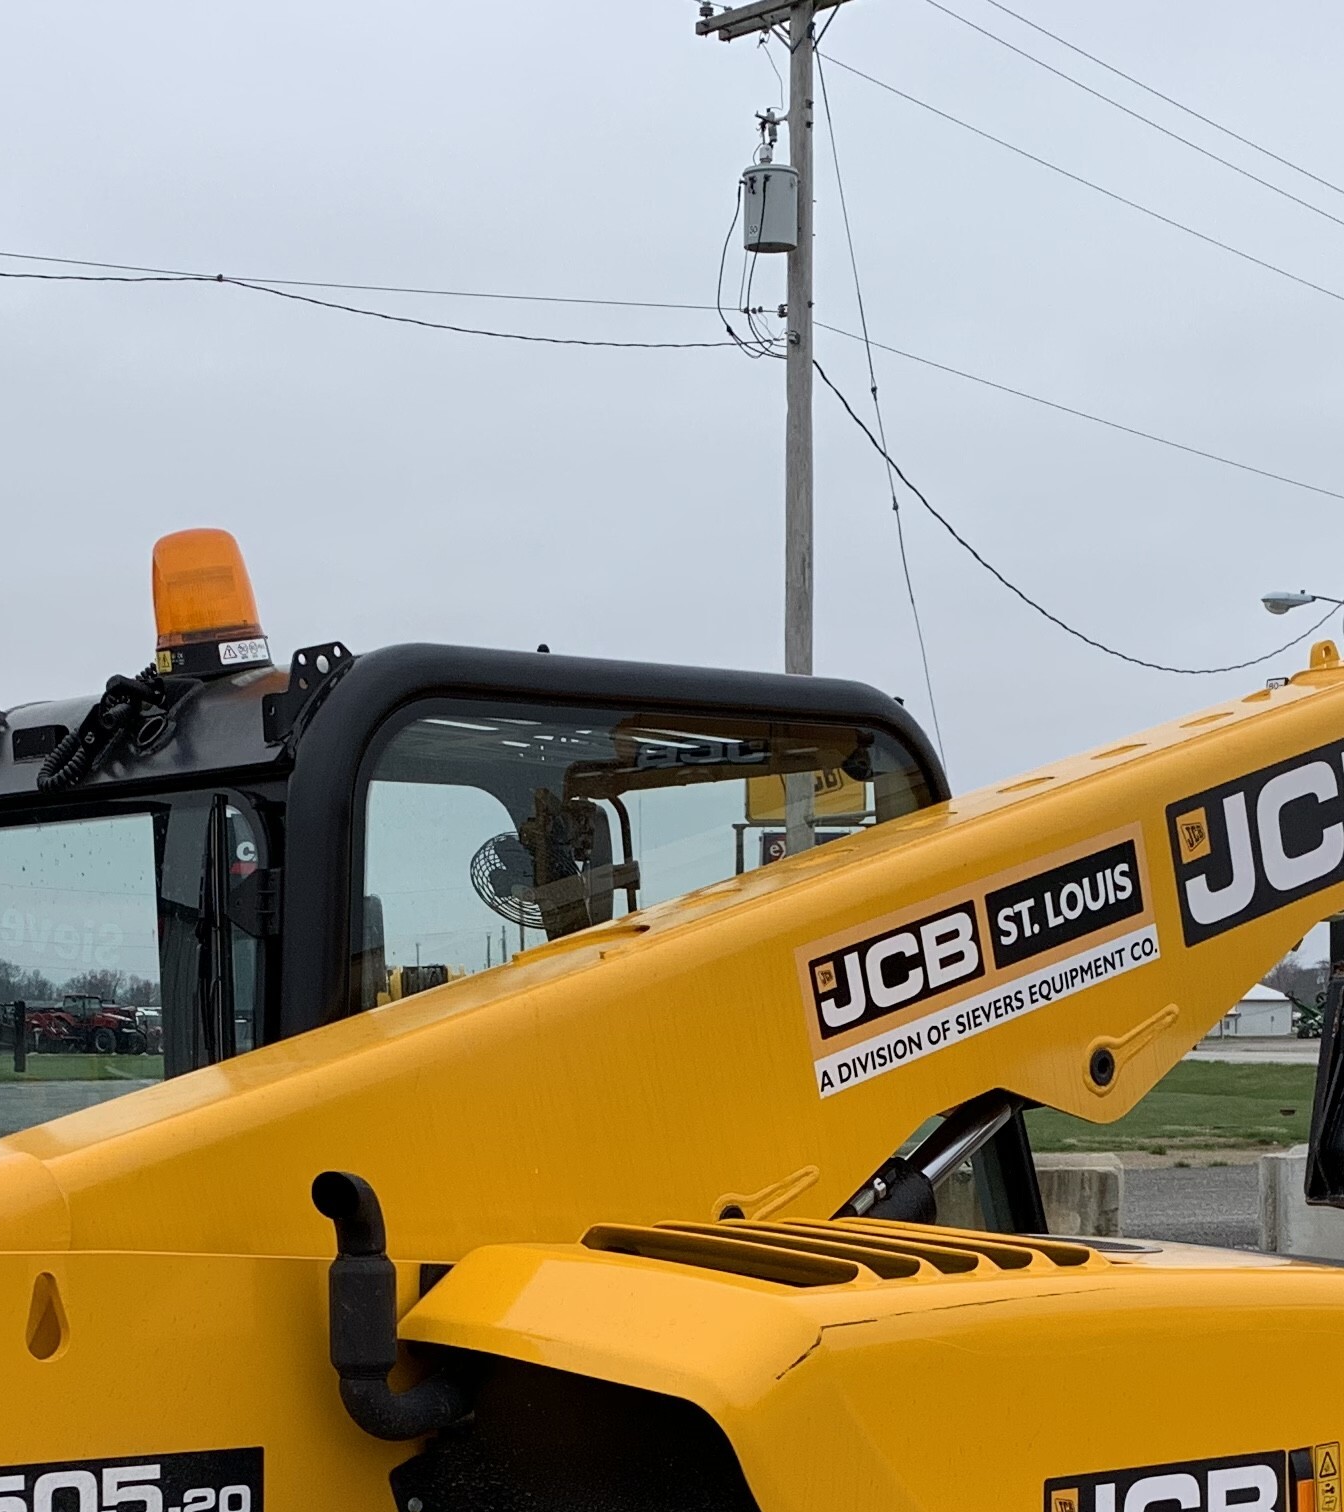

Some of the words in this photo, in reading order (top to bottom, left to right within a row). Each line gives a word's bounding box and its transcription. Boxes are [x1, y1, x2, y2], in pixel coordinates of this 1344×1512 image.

[1184, 823, 1205, 847] JCB
[820, 1070, 835, 1092] A
[837, 1035, 922, 1084] DIVISION
[927, 1021, 951, 1046] OF
[956, 990, 1025, 1035] SIEVERS
[1029, 947, 1126, 1005] EQUIPMENT
[1130, 936, 1159, 961] CO.
[821, 911, 980, 1028] JCB
[997, 898, 1040, 946] ST.
[1044, 863, 1134, 926] LOUIS
